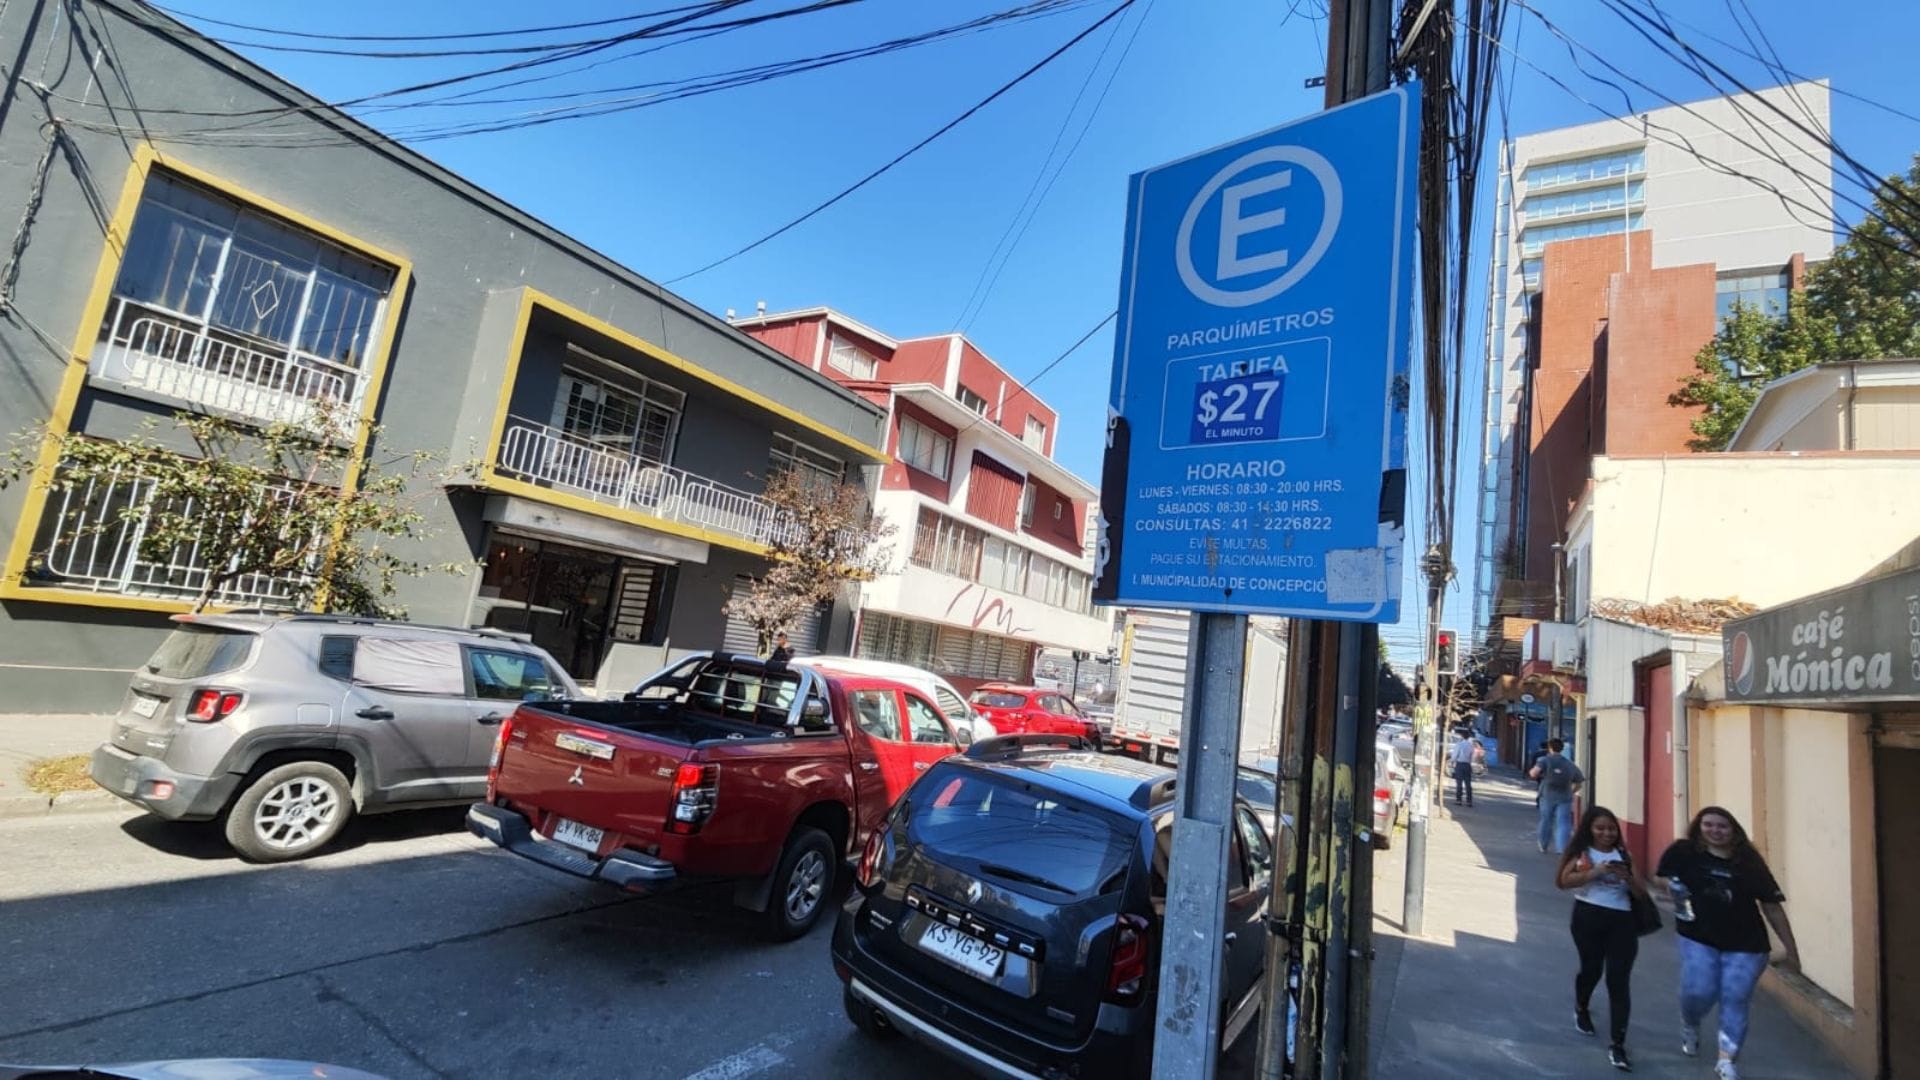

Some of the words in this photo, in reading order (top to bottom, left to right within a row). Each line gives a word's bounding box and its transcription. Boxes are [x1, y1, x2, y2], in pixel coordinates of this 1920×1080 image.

[1216, 168, 1292, 281] E
[1167, 307, 1334, 350] PARQUÍMETROS
[1198, 354, 1289, 383] TARIFA
[1197, 380, 1280, 428] $27
[1205, 429, 1219, 439] EL
[1221, 426, 1264, 438] MINUTO
[1187, 459, 1286, 480] HORARIO
[1139, 486, 1174, 499] LUNES
[1181, 483, 1234, 496] VIERNES:
[1236, 482, 1268, 495] 08:30
[1276, 480, 1310, 494] 20:00
[1313, 479, 1345, 492] HRS.
[1157, 500, 1214, 515] SÁBADOS:
[1216, 501, 1247, 513] 08:30
[1257, 500, 1289, 513] 14:30
[1291, 499, 1322, 512] HRS.
[1135, 518, 1226, 531] CONSULTAS:
[1231, 517, 1249, 531] 41
[1264, 516, 1332, 530] 2226822
[1150, 553, 1185, 565] PAGUE
[1186, 554, 1201, 565] SU
[1203, 554, 1317, 568] ETACIONAMIENTO.
[1140, 573, 1226, 588] MUNICIPALIDAD
[1229, 576, 1246, 590] DE
[1249, 576, 1327, 593] CONCEPCIÓ
[1791, 606, 1844, 648] café
[1765, 646, 1893, 694] Mónica
